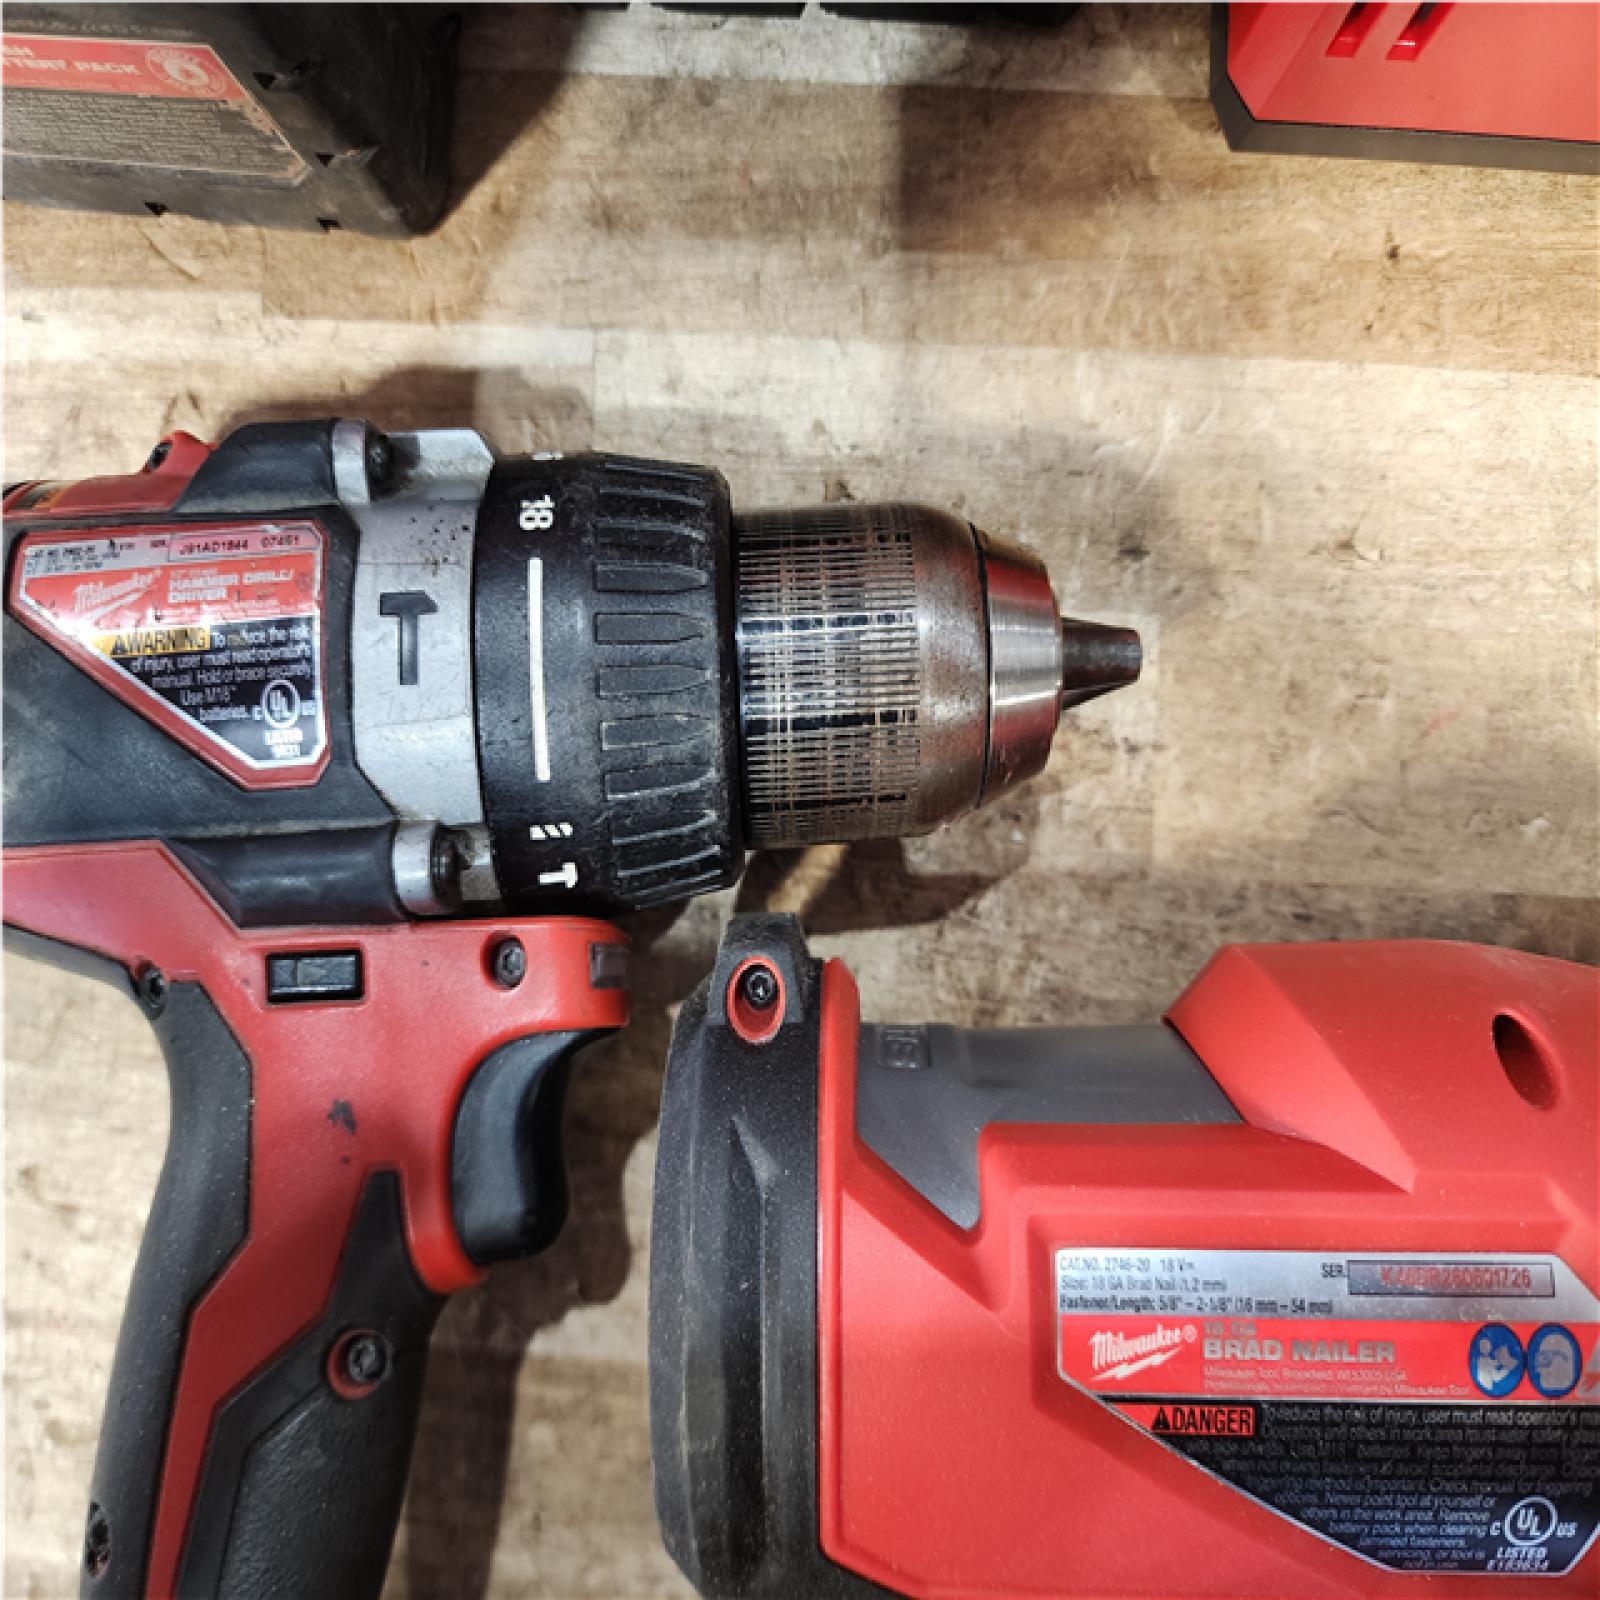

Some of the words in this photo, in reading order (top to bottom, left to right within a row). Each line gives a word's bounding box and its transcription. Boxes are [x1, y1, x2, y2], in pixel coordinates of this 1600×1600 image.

[519, 494, 555, 531] 18
[124, 627, 208, 654] WARNING
[1089, 1324, 1182, 1371] Milwaukee
[1203, 1338, 1282, 1361] BRAD
[1291, 1339, 1395, 1364] NAILER
[1172, 1407, 1252, 1434] DANGER
